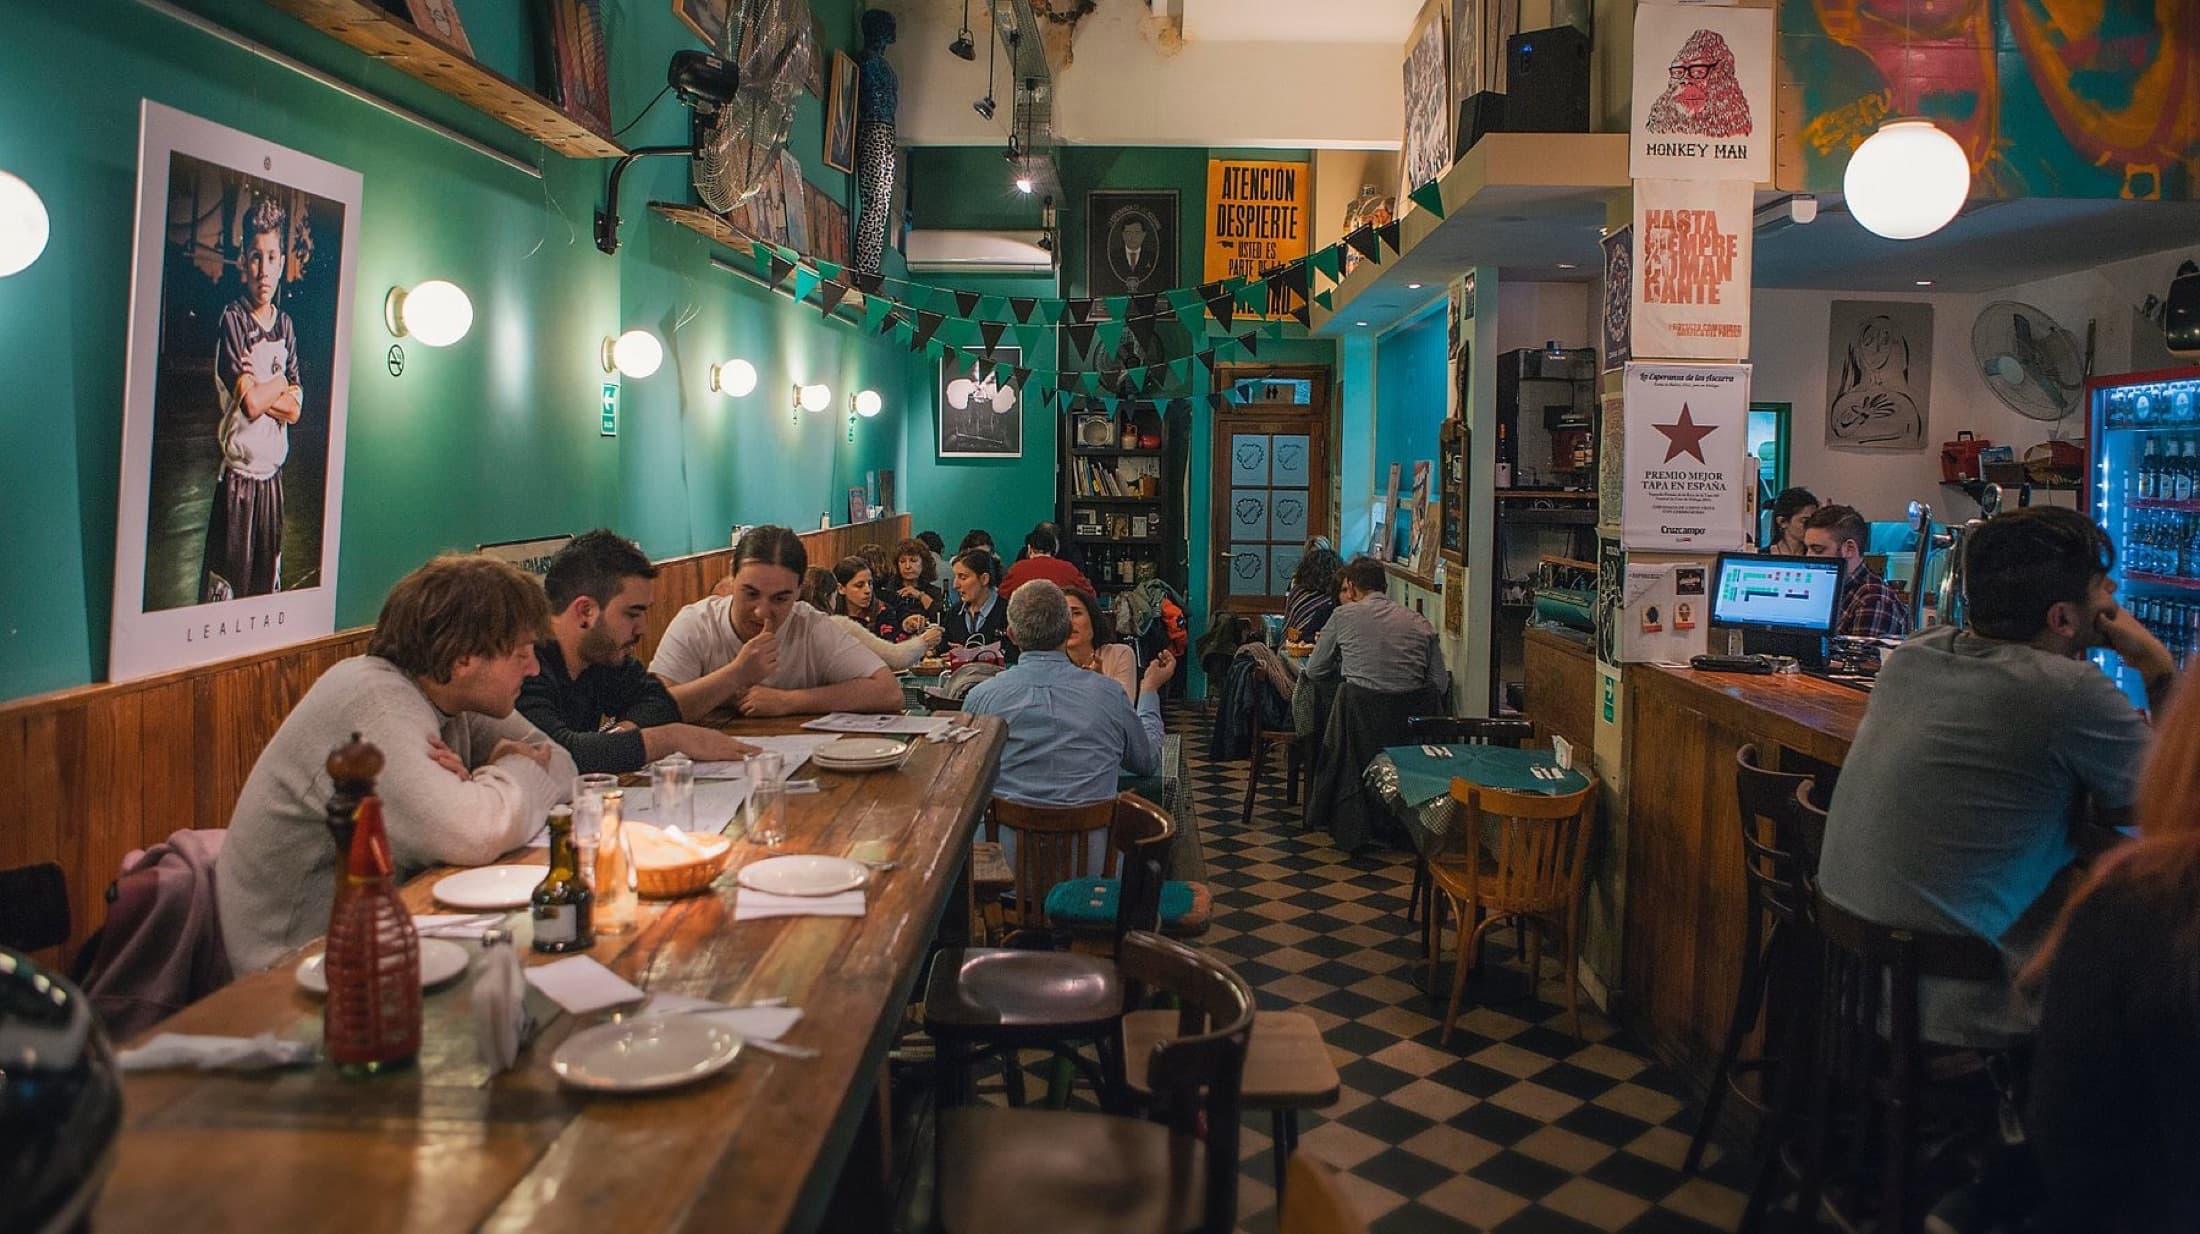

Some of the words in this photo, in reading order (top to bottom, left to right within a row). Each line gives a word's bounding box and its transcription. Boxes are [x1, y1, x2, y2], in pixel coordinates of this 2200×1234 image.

[1646, 143, 1709, 157] MONKEY
[1714, 145, 1747, 159] MAN
[1216, 203, 1298, 240] DESPIERTE
[1644, 209, 1720, 234] HASTA
[1238, 241, 1262, 259] USTED
[1266, 242, 1277, 259] ES
[1228, 258, 1253, 278] PARTE
[1641, 481, 1668, 490] TAPA
[1670, 481, 1685, 491] EN
[1687, 480, 1727, 491] ESPAÑA
[1645, 471, 1687, 480] PREMIO
[1688, 471, 1723, 482] MEJOR
[1660, 525, 1706, 536] Cruzcampo
[186, 611, 286, 642] LEALTAD
